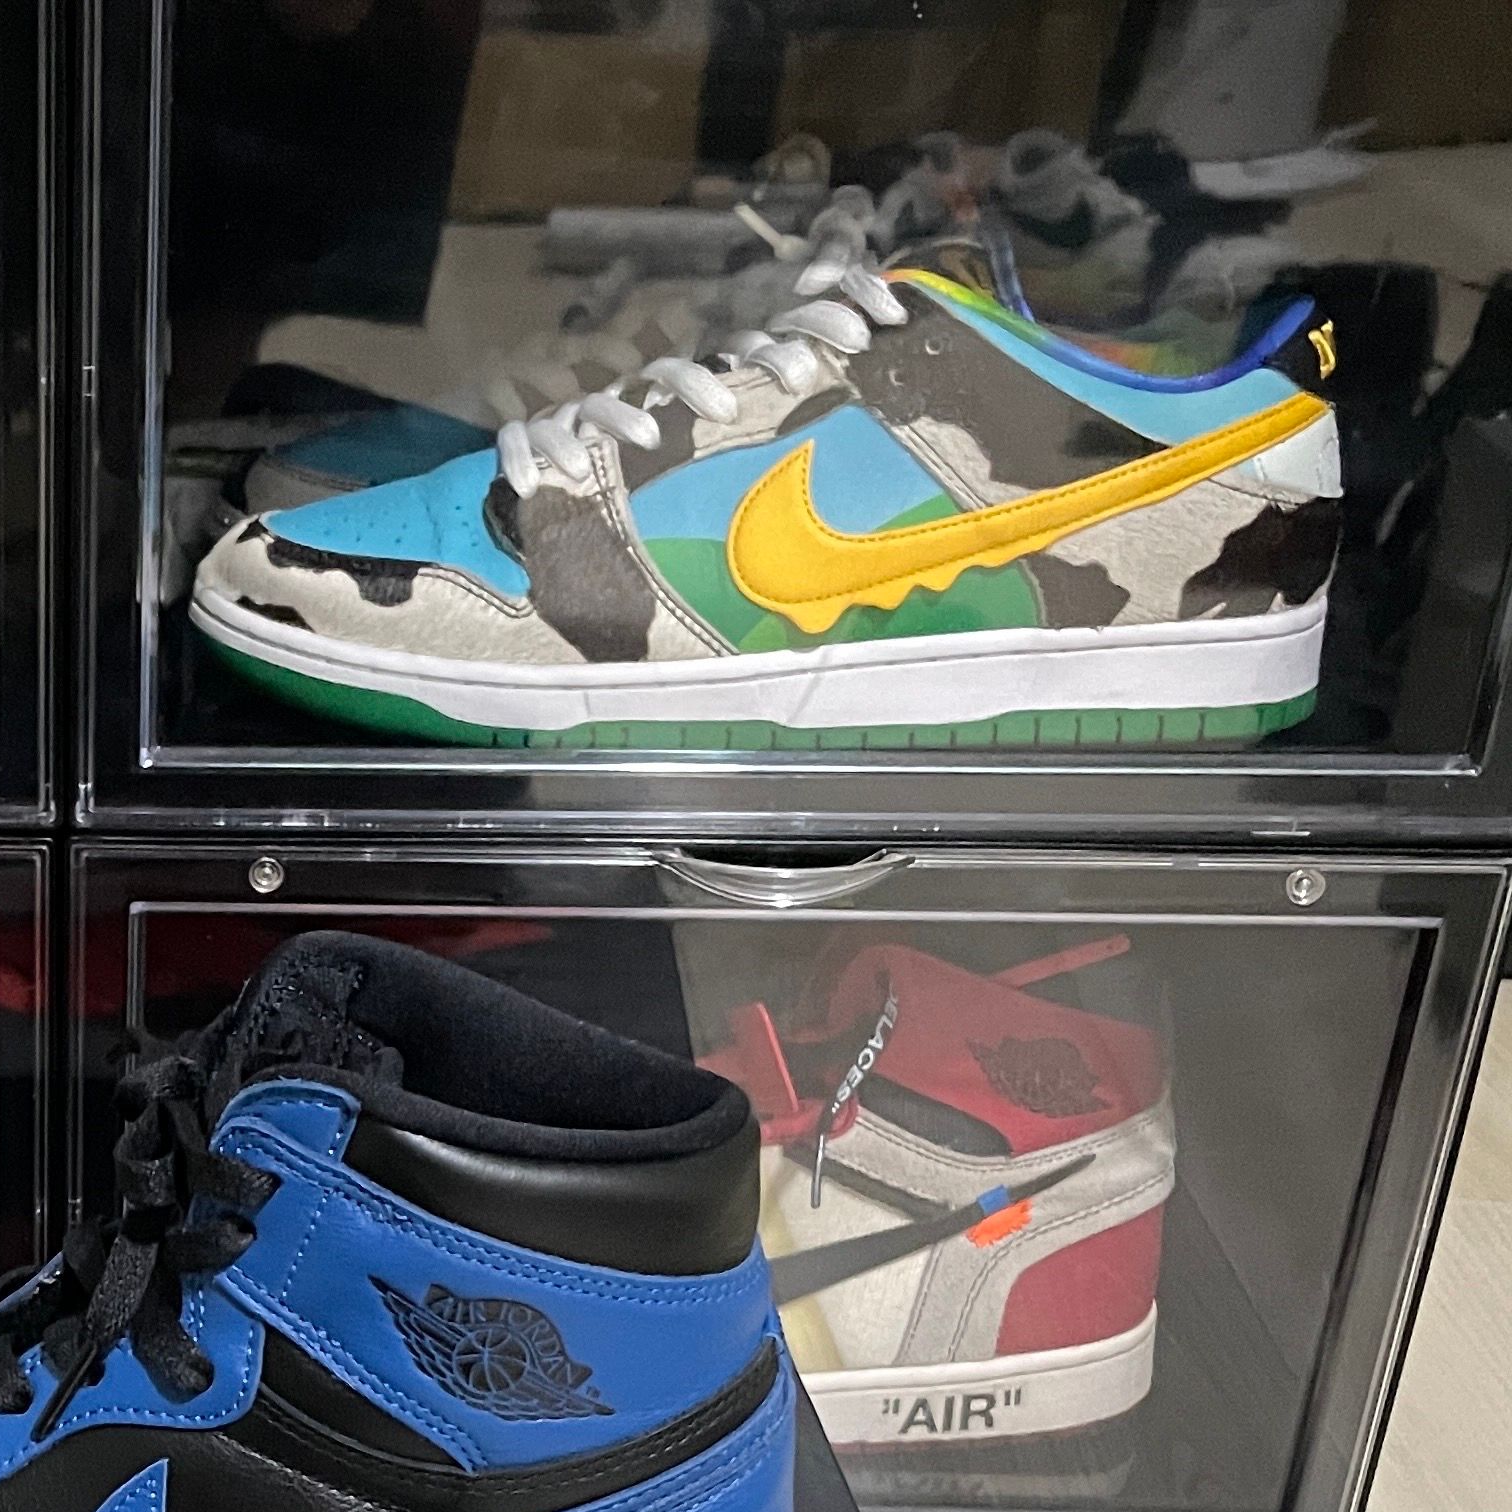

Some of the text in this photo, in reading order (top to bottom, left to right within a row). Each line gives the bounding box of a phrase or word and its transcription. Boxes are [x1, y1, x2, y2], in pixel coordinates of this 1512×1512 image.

[430, 1297, 572, 1387] AIR JORDAN
[881, 1386, 1023, 1435] "AIR"
